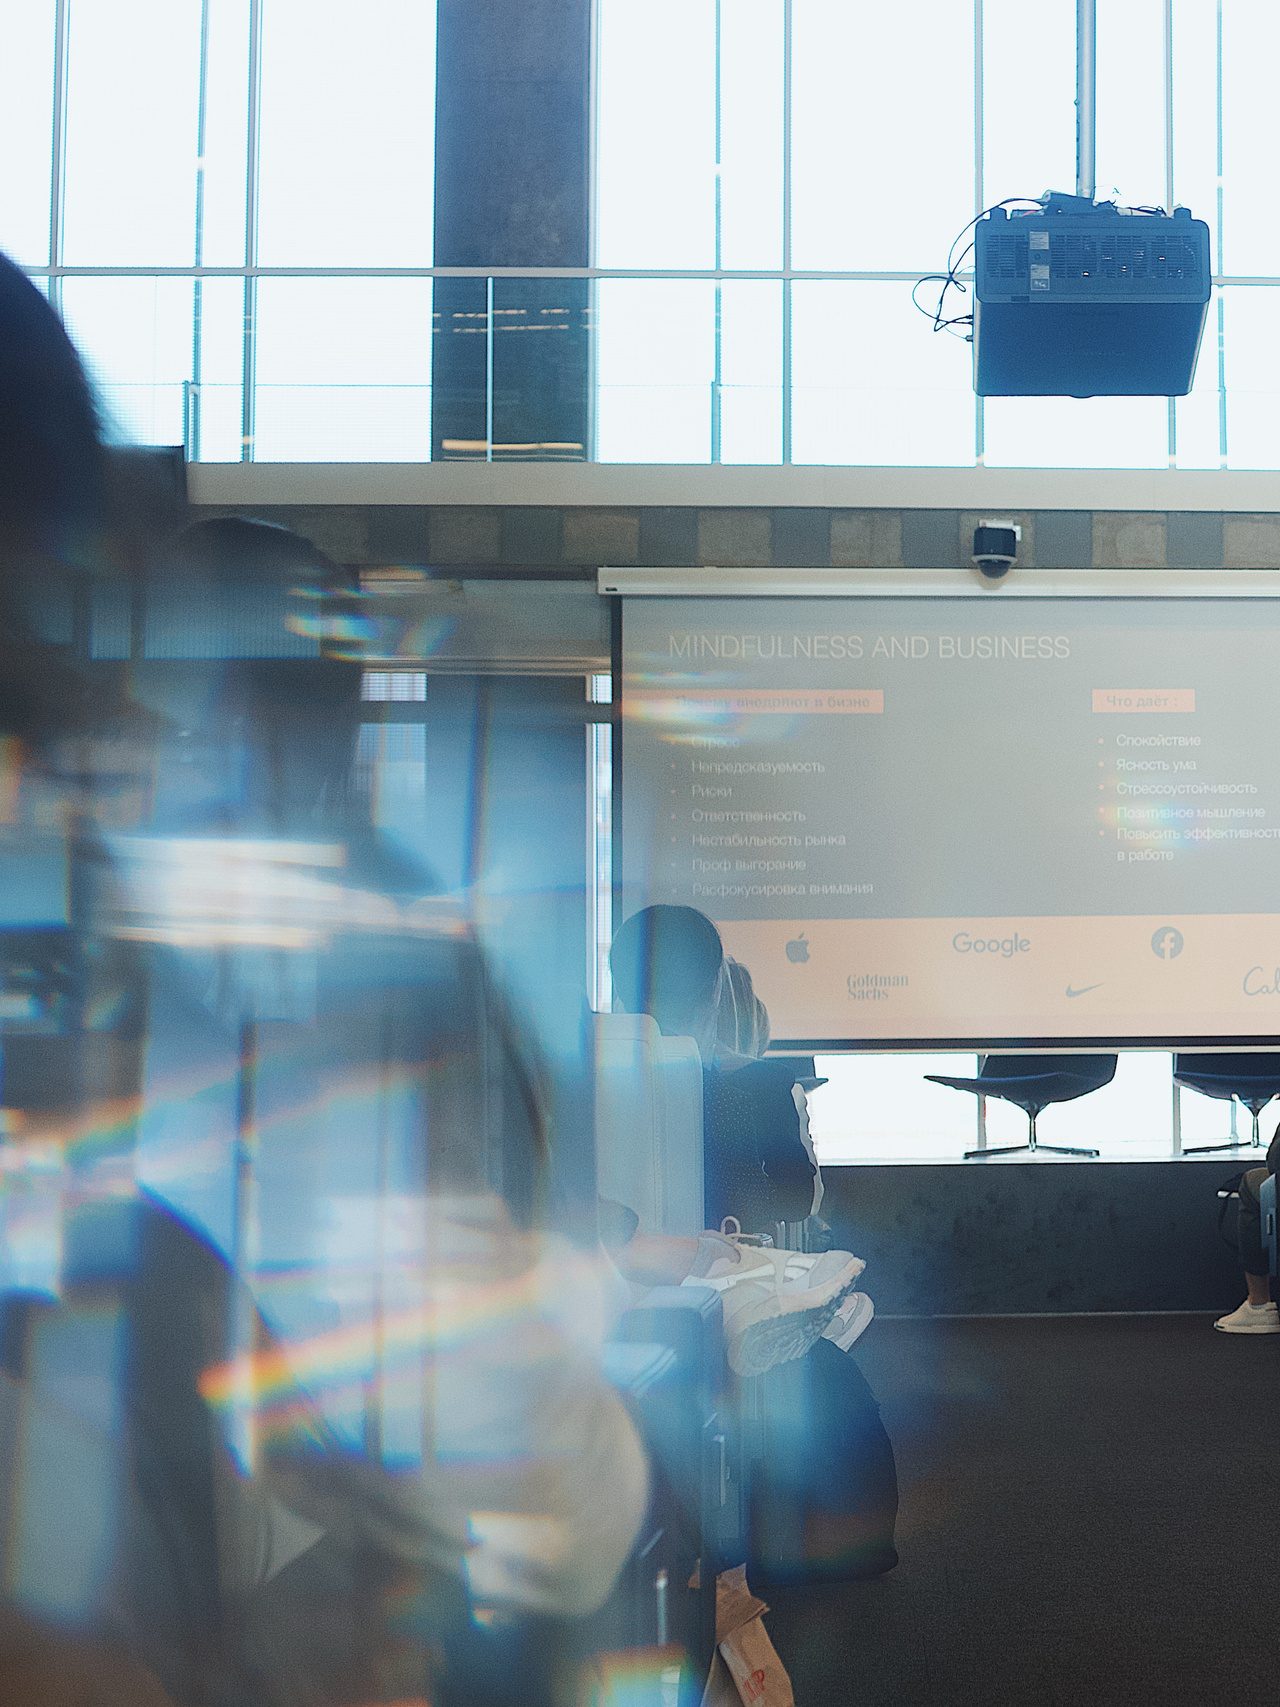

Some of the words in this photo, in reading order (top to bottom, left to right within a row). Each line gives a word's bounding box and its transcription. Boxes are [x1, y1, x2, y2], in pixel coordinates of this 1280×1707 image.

[669, 634, 863, 659] MINDFULNESS
[871, 635, 930, 659] AND
[938, 635, 1070, 659] BUSINESS
[1106, 695, 1133, 707] Что
[1136, 694, 1169, 708] даёт
[1116, 734, 1202, 747] Спокойствие
[692, 761, 826, 776] Непредсказуемость
[1116, 758, 1170, 771] Ясность
[1173, 761, 1197, 773] ума
[692, 785, 733, 798] Риски
[1116, 782, 1258, 797] Стрессоустойчивость
[692, 809, 807, 822] Ответственность
[1117, 806, 1195, 819] Позитивное
[1196, 807, 1266, 819] мышление
[1117, 827, 1181, 840] Повысить
[692, 834, 801, 846] Нестабильность
[805, 834, 847, 848] рынка
[1116, 851, 1125, 861] в
[1128, 849, 1174, 863] работе
[692, 858, 732, 873] Проф
[735, 859, 807, 872] выгорание
[809, 883, 874, 895] внимания
[952, 932, 1031, 958] Google
[846, 974, 909, 988] Goldman
[848, 987, 889, 1000] Sachs
